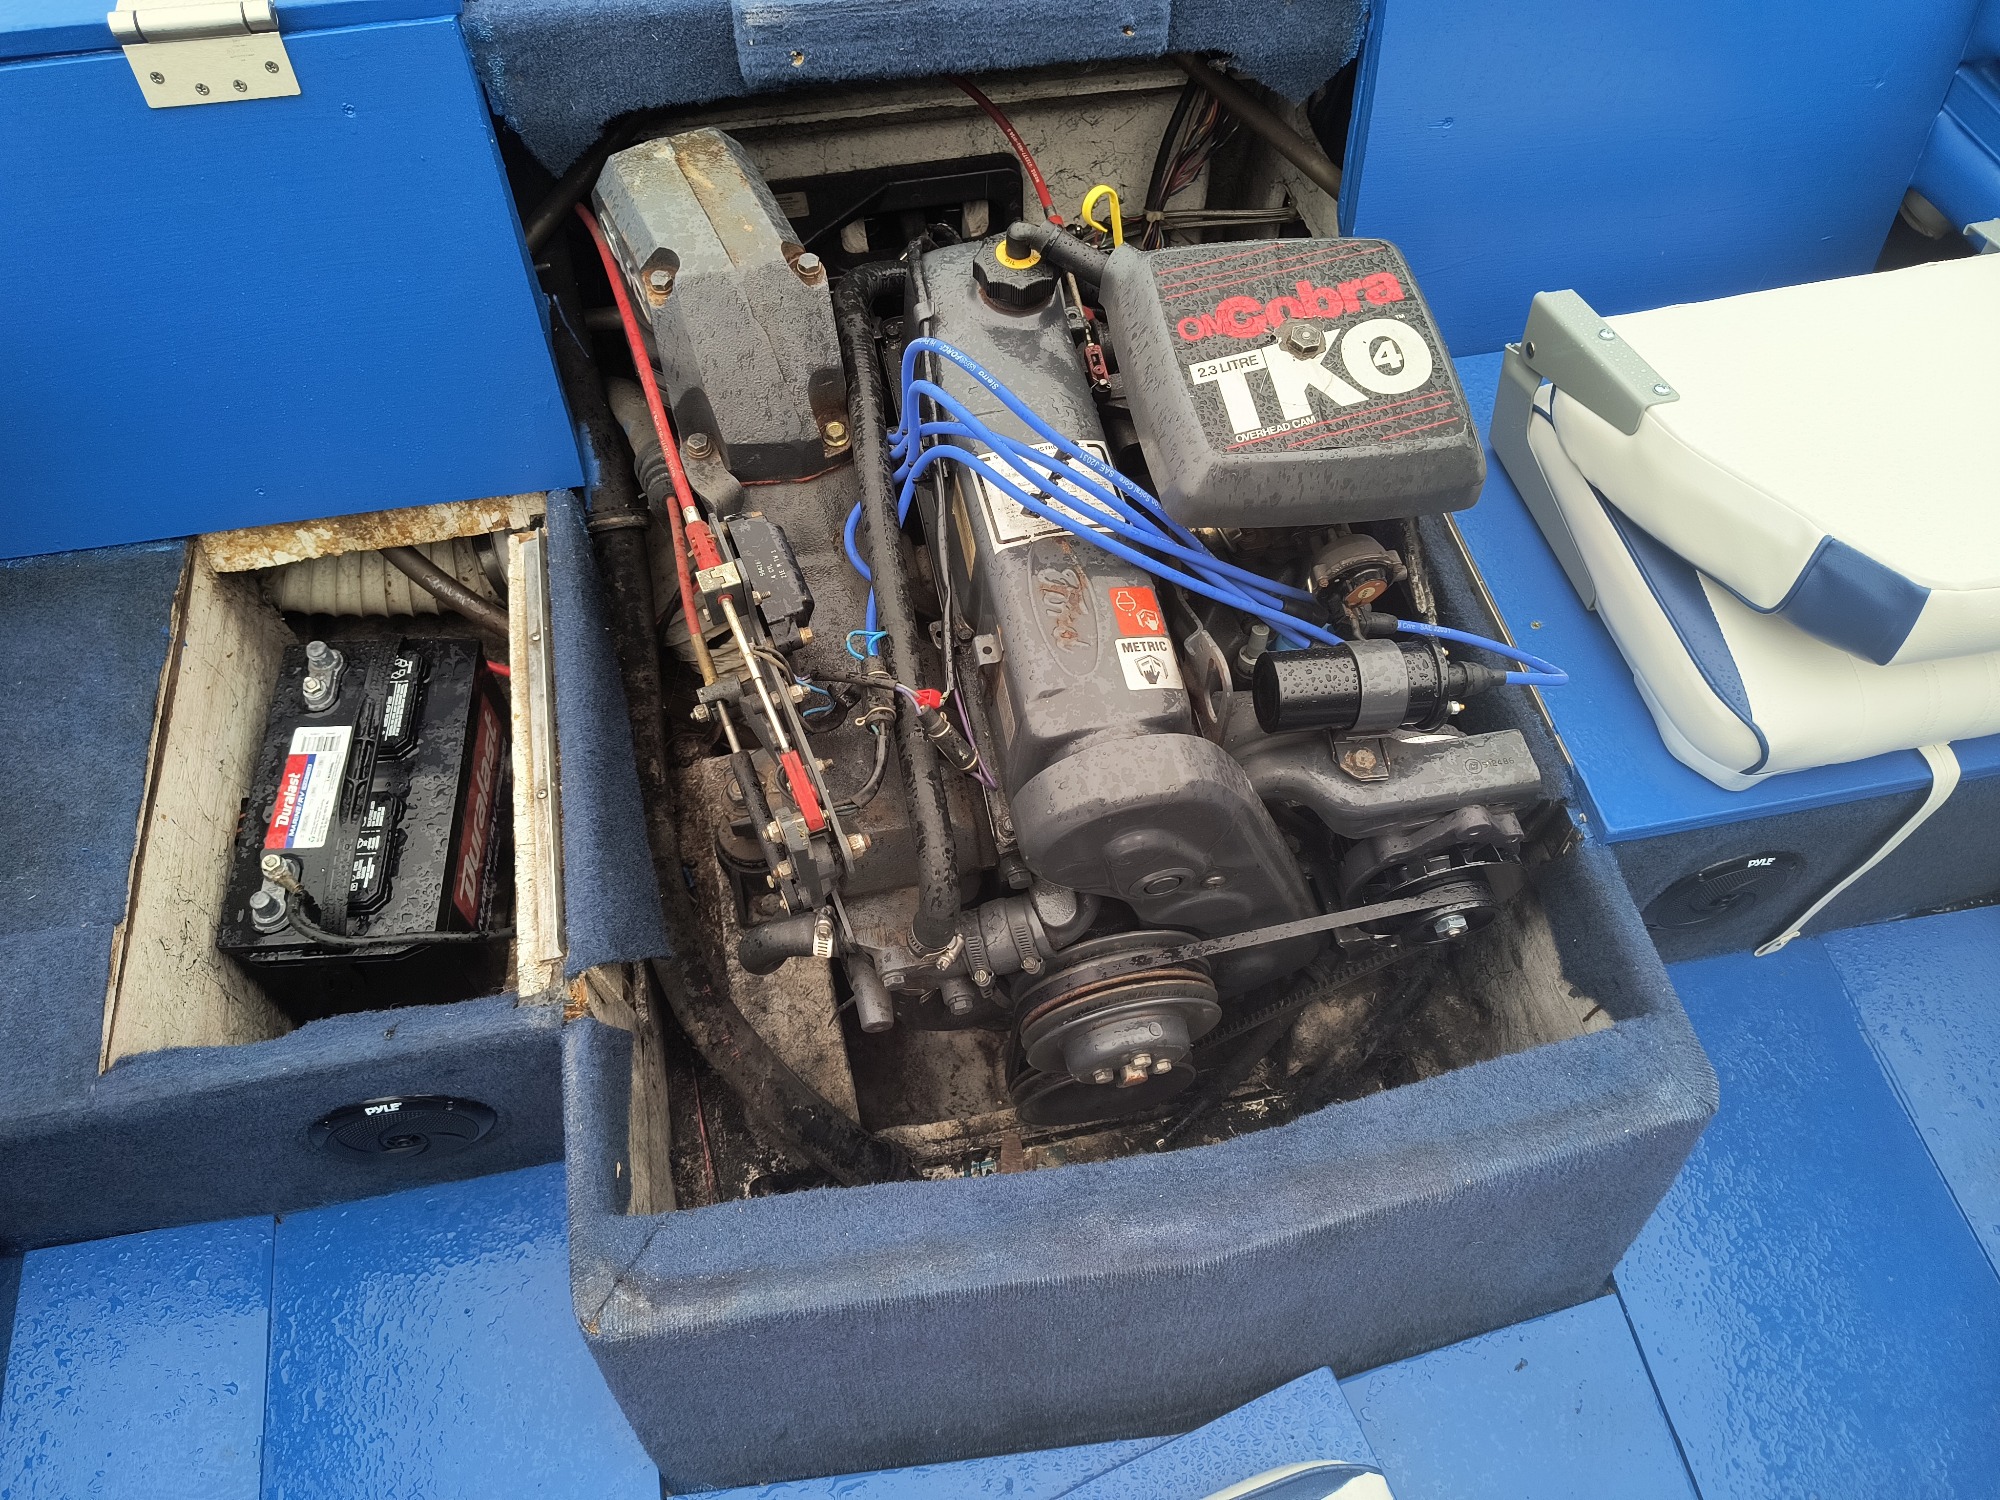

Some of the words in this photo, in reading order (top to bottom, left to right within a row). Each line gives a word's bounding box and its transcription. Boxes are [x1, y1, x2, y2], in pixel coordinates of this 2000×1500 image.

[1372, 340, 1404, 370] 4
[1197, 363, 1219, 378] 2.3
[1220, 355, 1260, 375] LITRE
[977, 370, 999, 390] Sierra
[1189, 318, 1433, 435] TKO
[1235, 421, 1291, 443] OVERHEAD
[1292, 415, 1317, 430] CAM
[1079, 452, 1100, 467] J2031
[1099, 464, 1115, 478] SAE
[1119, 476, 1134, 490] Core
[1134, 487, 1150, 503] Spiral
[1420, 624, 1433, 632] SAE
[1121, 640, 1168, 653] METRIC
[275, 772, 302, 829] Duralast
[459, 709, 498, 907] Duralast
[1747, 857, 1775, 868] PYLE
[364, 1102, 401, 1116] PYLE
